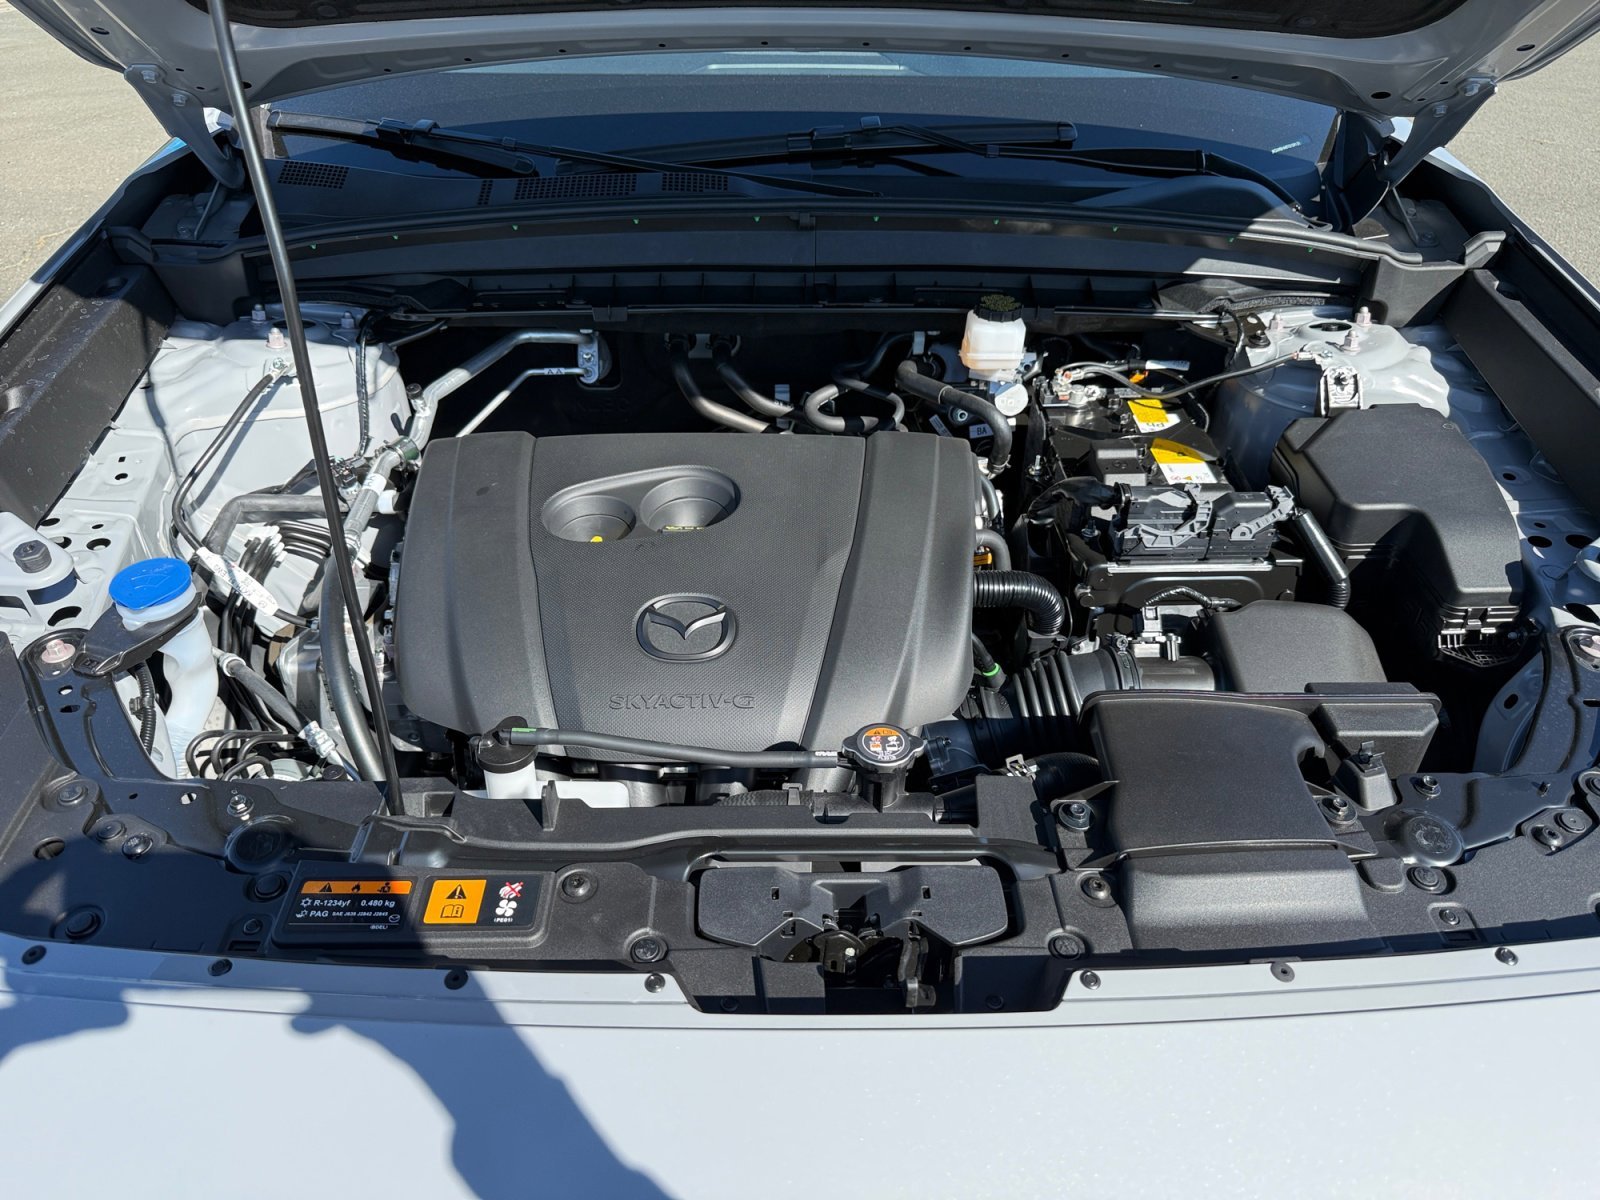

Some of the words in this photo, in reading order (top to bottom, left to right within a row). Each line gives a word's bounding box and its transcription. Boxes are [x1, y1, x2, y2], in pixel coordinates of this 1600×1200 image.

[608, 693, 755, 710] SKYACTIV-G
[313, 899, 351, 908] R-1234yf
[360, 899, 383, 907] 0.480
[384, 899, 396, 908] kg
[309, 910, 329, 918] PAG
